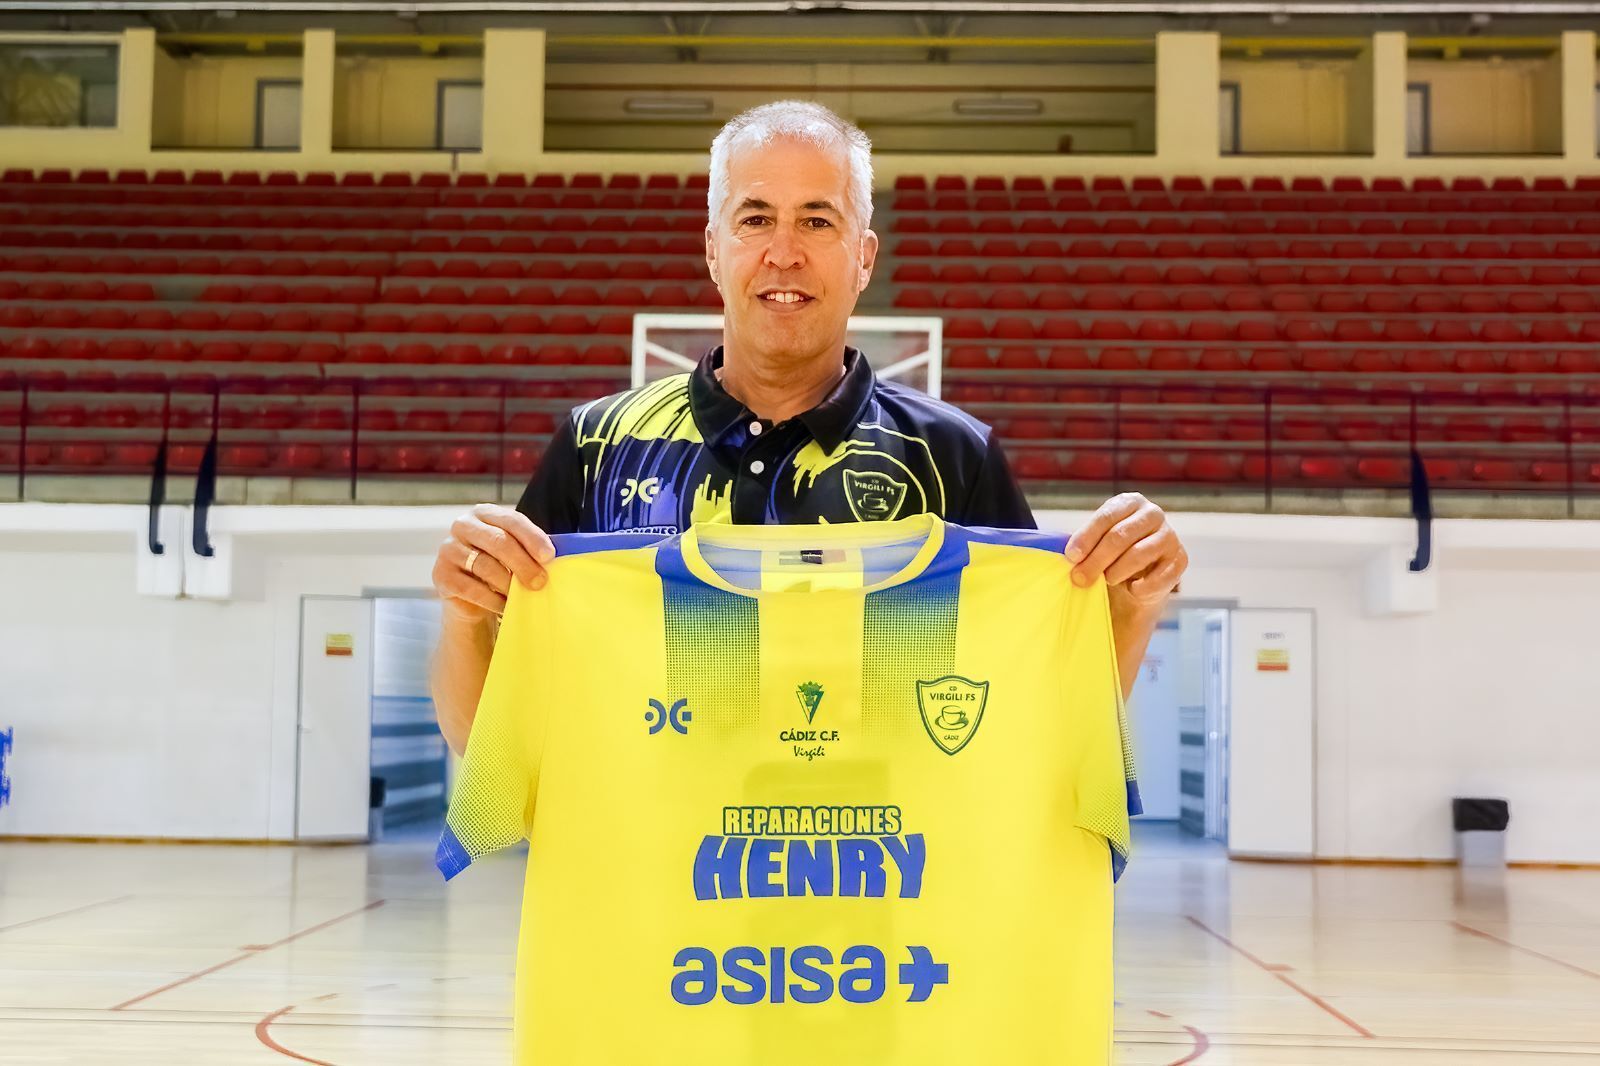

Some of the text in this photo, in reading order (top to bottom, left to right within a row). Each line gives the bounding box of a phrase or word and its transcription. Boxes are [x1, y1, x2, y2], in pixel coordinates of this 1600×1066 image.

[854, 480, 884, 491] VIRGILI
[930, 693, 976, 701] VIRGILI FS
[780, 728, 840, 741] CÁDIZ C.F.
[793, 745, 825, 761] Virgili
[723, 806, 903, 835] REPARACIONES
[693, 833, 926, 901] HENRY
[671, 945, 886, 1006] asisa
